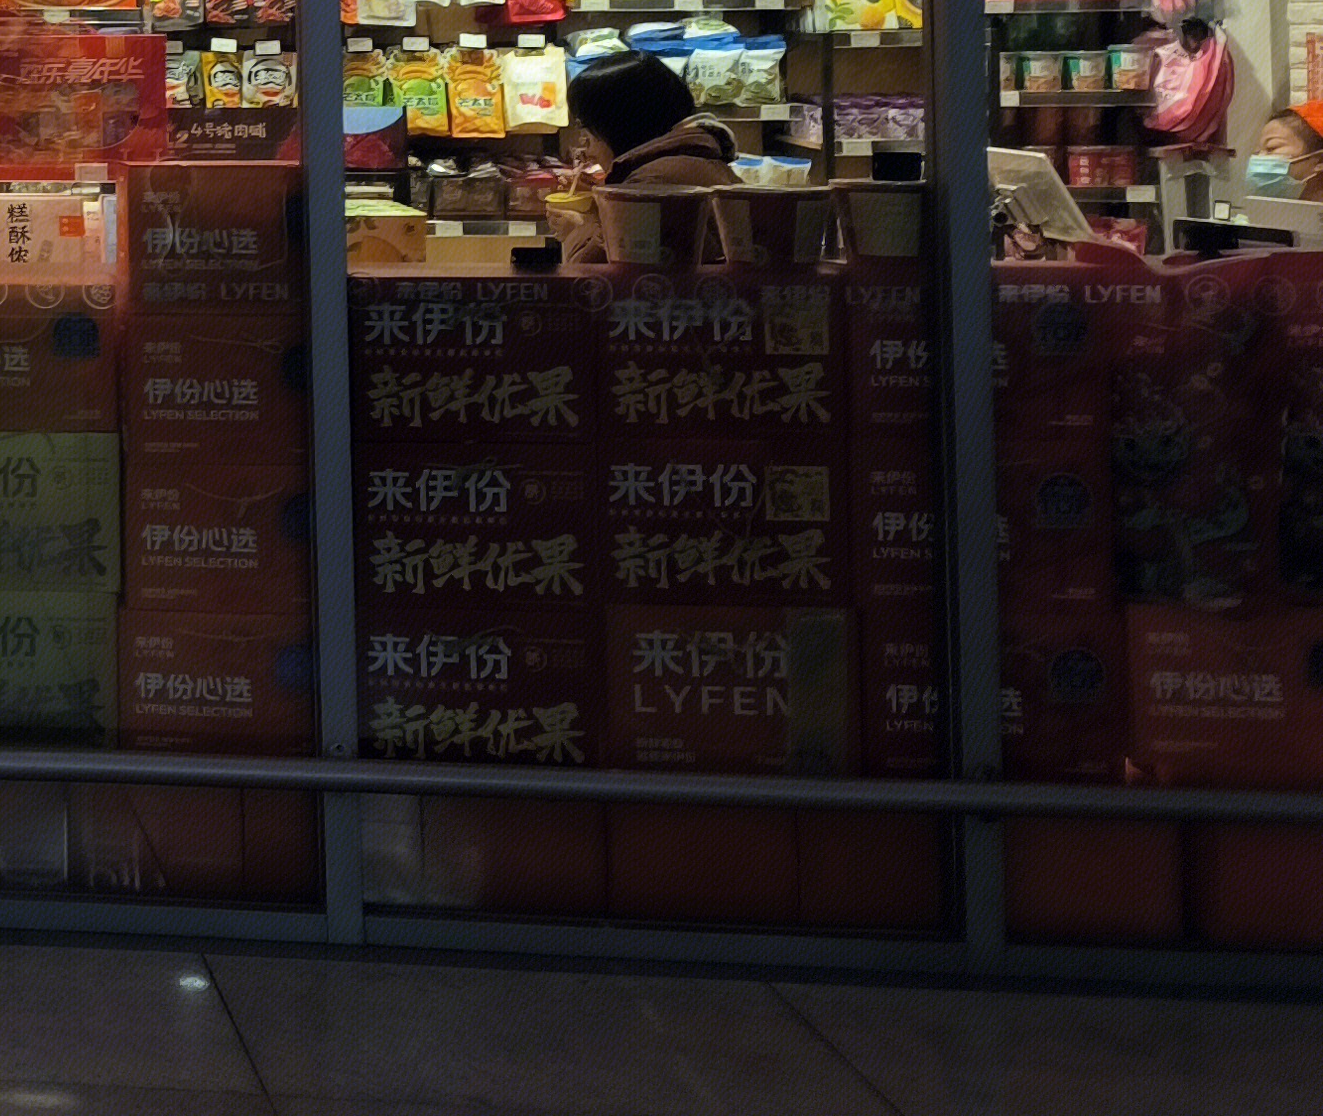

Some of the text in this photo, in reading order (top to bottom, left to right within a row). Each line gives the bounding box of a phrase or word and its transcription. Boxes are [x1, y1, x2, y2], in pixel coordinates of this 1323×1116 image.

[143, 227, 259, 255] 伊份心选
[363, 301, 508, 346] 来伊份
[609, 298, 756, 342] 来伊份
[142, 377, 259, 406] 伊份心选
[365, 364, 582, 428] 新鲜优果
[610, 359, 833, 425] 新鲜优果
[368, 468, 512, 513] 来伊份
[608, 462, 758, 508] 来伊份
[140, 523, 258, 554] 伊份心选
[610, 525, 833, 591] 新鲜优果
[369, 529, 586, 596] 新鲜优果
[368, 633, 513, 680] 来伊份
[632, 629, 790, 680] 来伊份
[134, 671, 254, 704] 伊份心选
[634, 683, 791, 717] LYFEN
[368, 695, 587, 764] 新鲜优果
